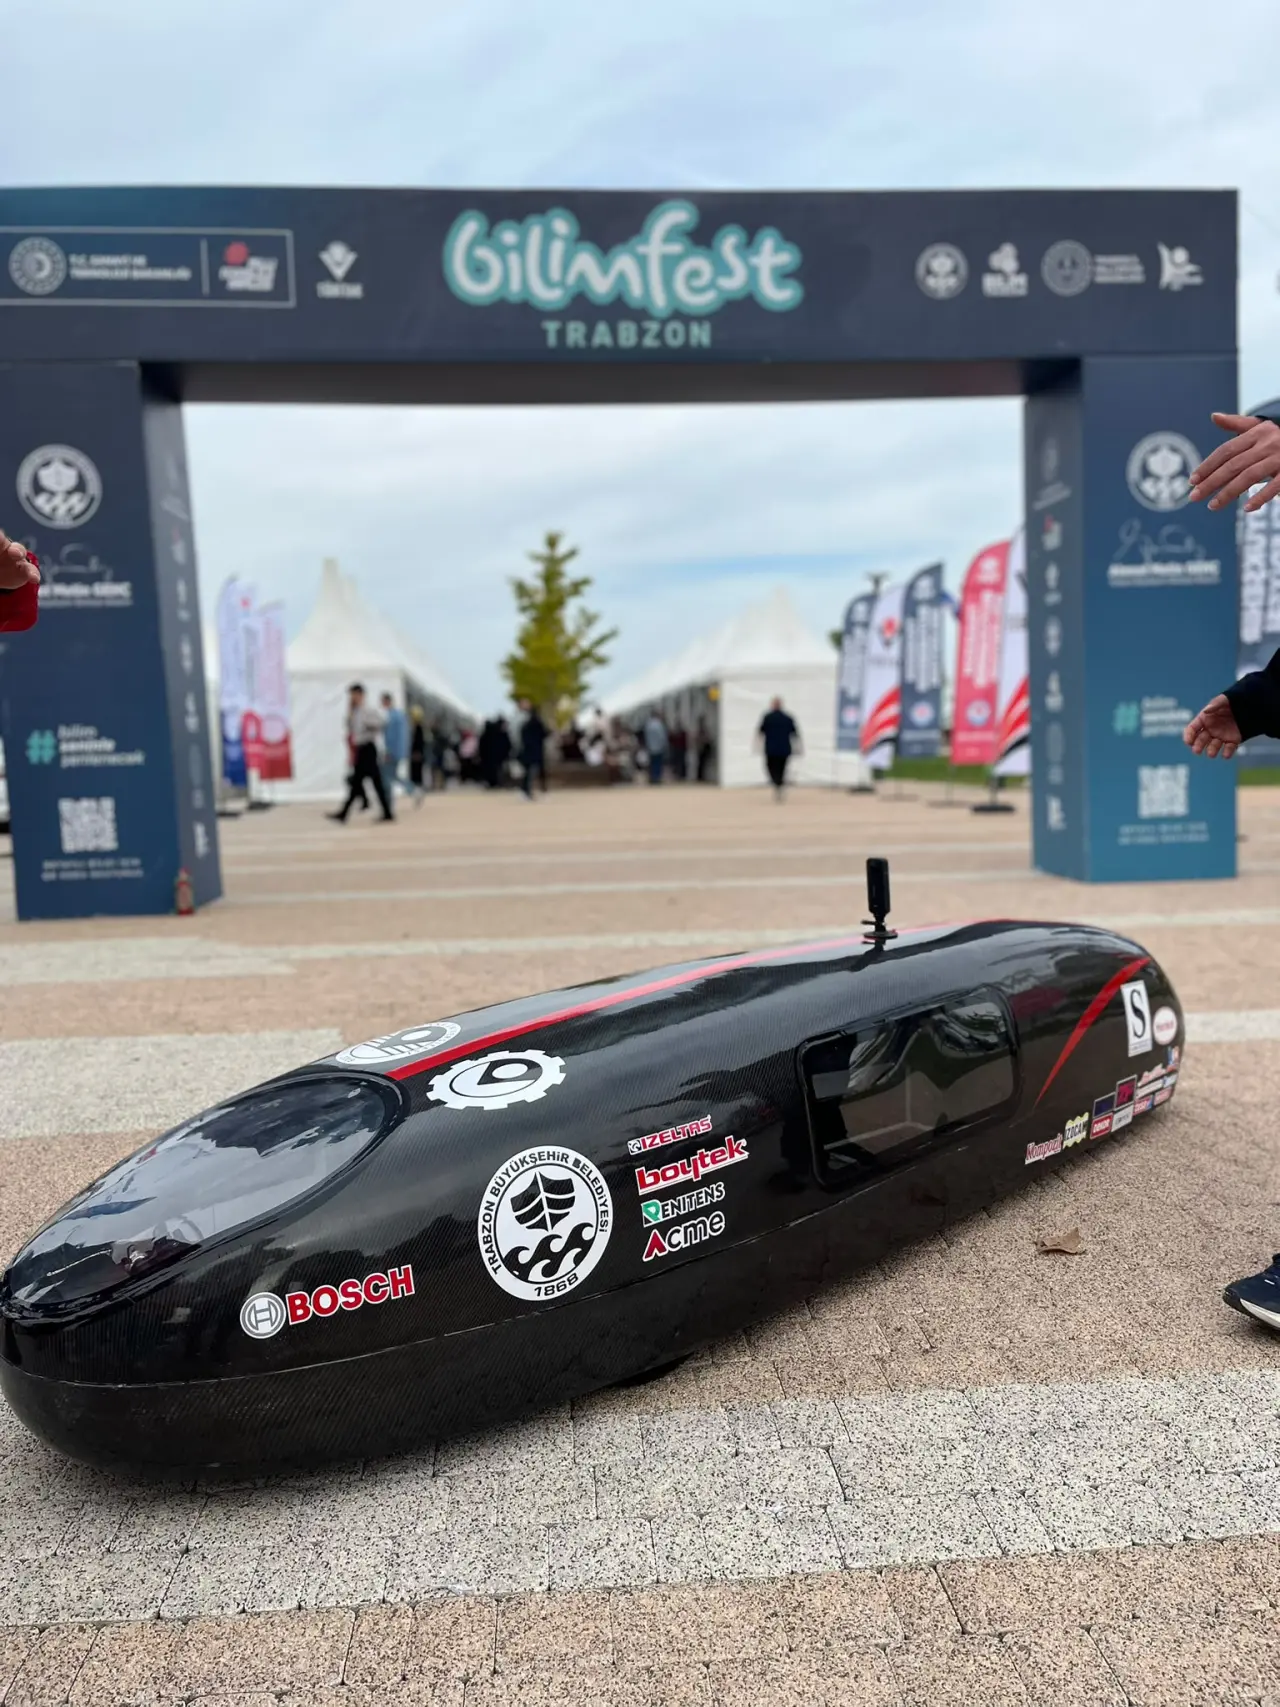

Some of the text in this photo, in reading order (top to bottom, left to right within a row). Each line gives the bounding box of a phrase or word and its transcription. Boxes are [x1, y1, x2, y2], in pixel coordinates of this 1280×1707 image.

[446, 203, 801, 314] bilimfest
[542, 320, 712, 348] TRABZON
[635, 1136, 746, 1193] boytek
[481, 1148, 611, 1276] TRABZON BÜYÜKŞEHİR BELEDİYESİ
[285, 1263, 416, 1327] BOSCH
[533, 1272, 579, 1298] 1868
